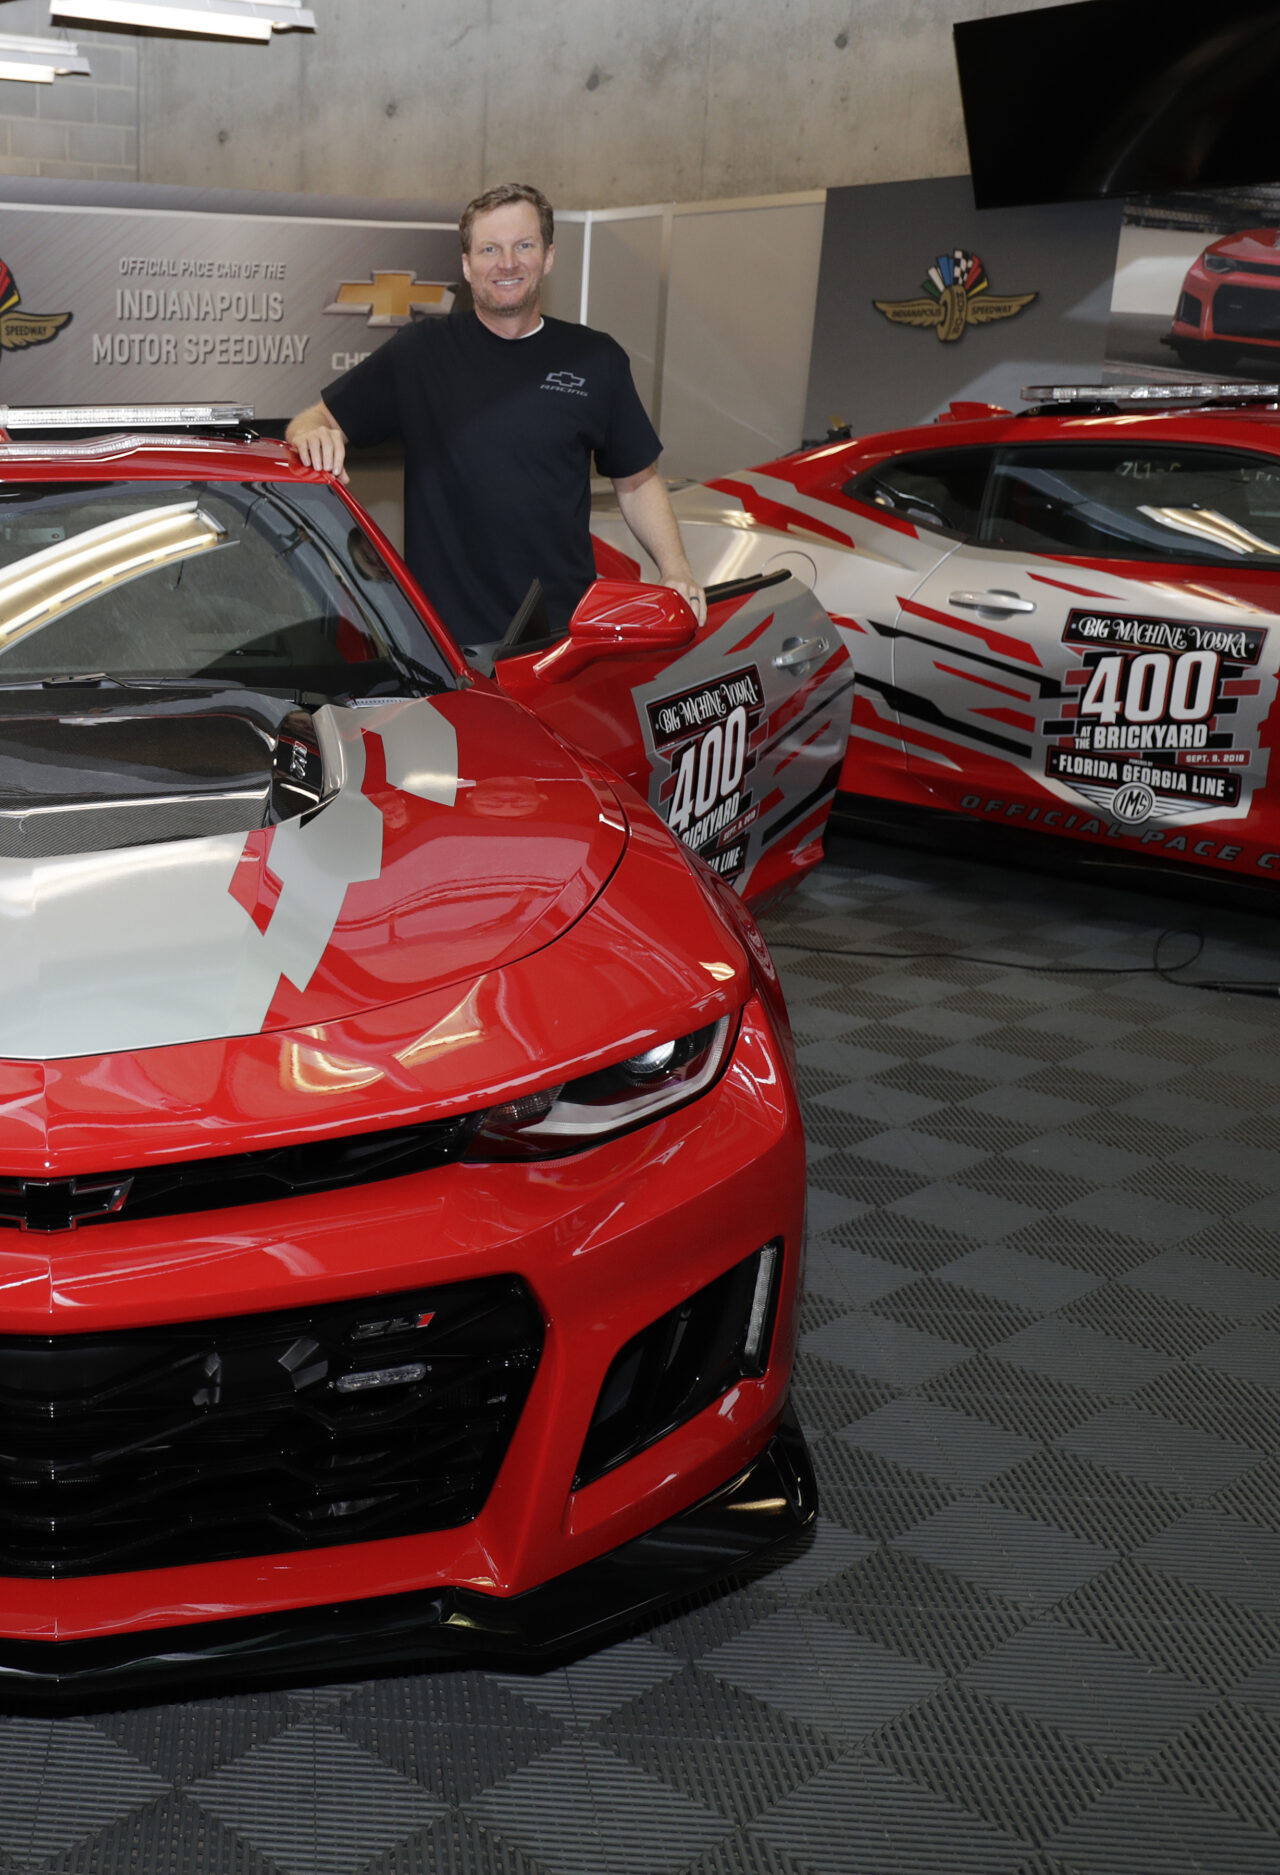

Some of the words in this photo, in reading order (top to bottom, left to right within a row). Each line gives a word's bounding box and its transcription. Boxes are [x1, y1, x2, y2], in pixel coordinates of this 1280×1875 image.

[120, 257, 178, 277] OFFICIAL
[181, 260, 214, 278] PACE
[217, 261, 241, 279] CAR
[244, 263, 260, 279] OF
[263, 263, 286, 280] THE
[116, 289, 285, 322] INDIANAPOLIS
[5, 325, 47, 337] SPEEDWAY
[92, 333, 177, 365] MOTOR
[183, 334, 310, 365] SPEEDWAY
[1078, 616, 1110, 638] BIG
[1112, 618, 1187, 650] MACHINE
[1187, 625, 1248, 658] VODKA
[1081, 650, 1219, 724] 400
[658, 706, 681, 734] BIG
[678, 690, 727, 725] MACHINE
[720, 675, 758, 708] VODKA
[1074, 737, 1091, 750] THE
[1080, 726, 1092, 738] AT
[1092, 724, 1208, 750] BRICKYARD
[668, 705, 746, 834] 400
[1058, 754, 1118, 780] FLORIDA
[1122, 762, 1188, 792] GEORGIA
[1191, 777, 1226, 798] LINE
[1119, 789, 1148, 818] IMS
[960, 795, 1123, 839] OFFICIAL
[1140, 829, 1244, 861] PACE
[720, 846, 741, 873] LINE
